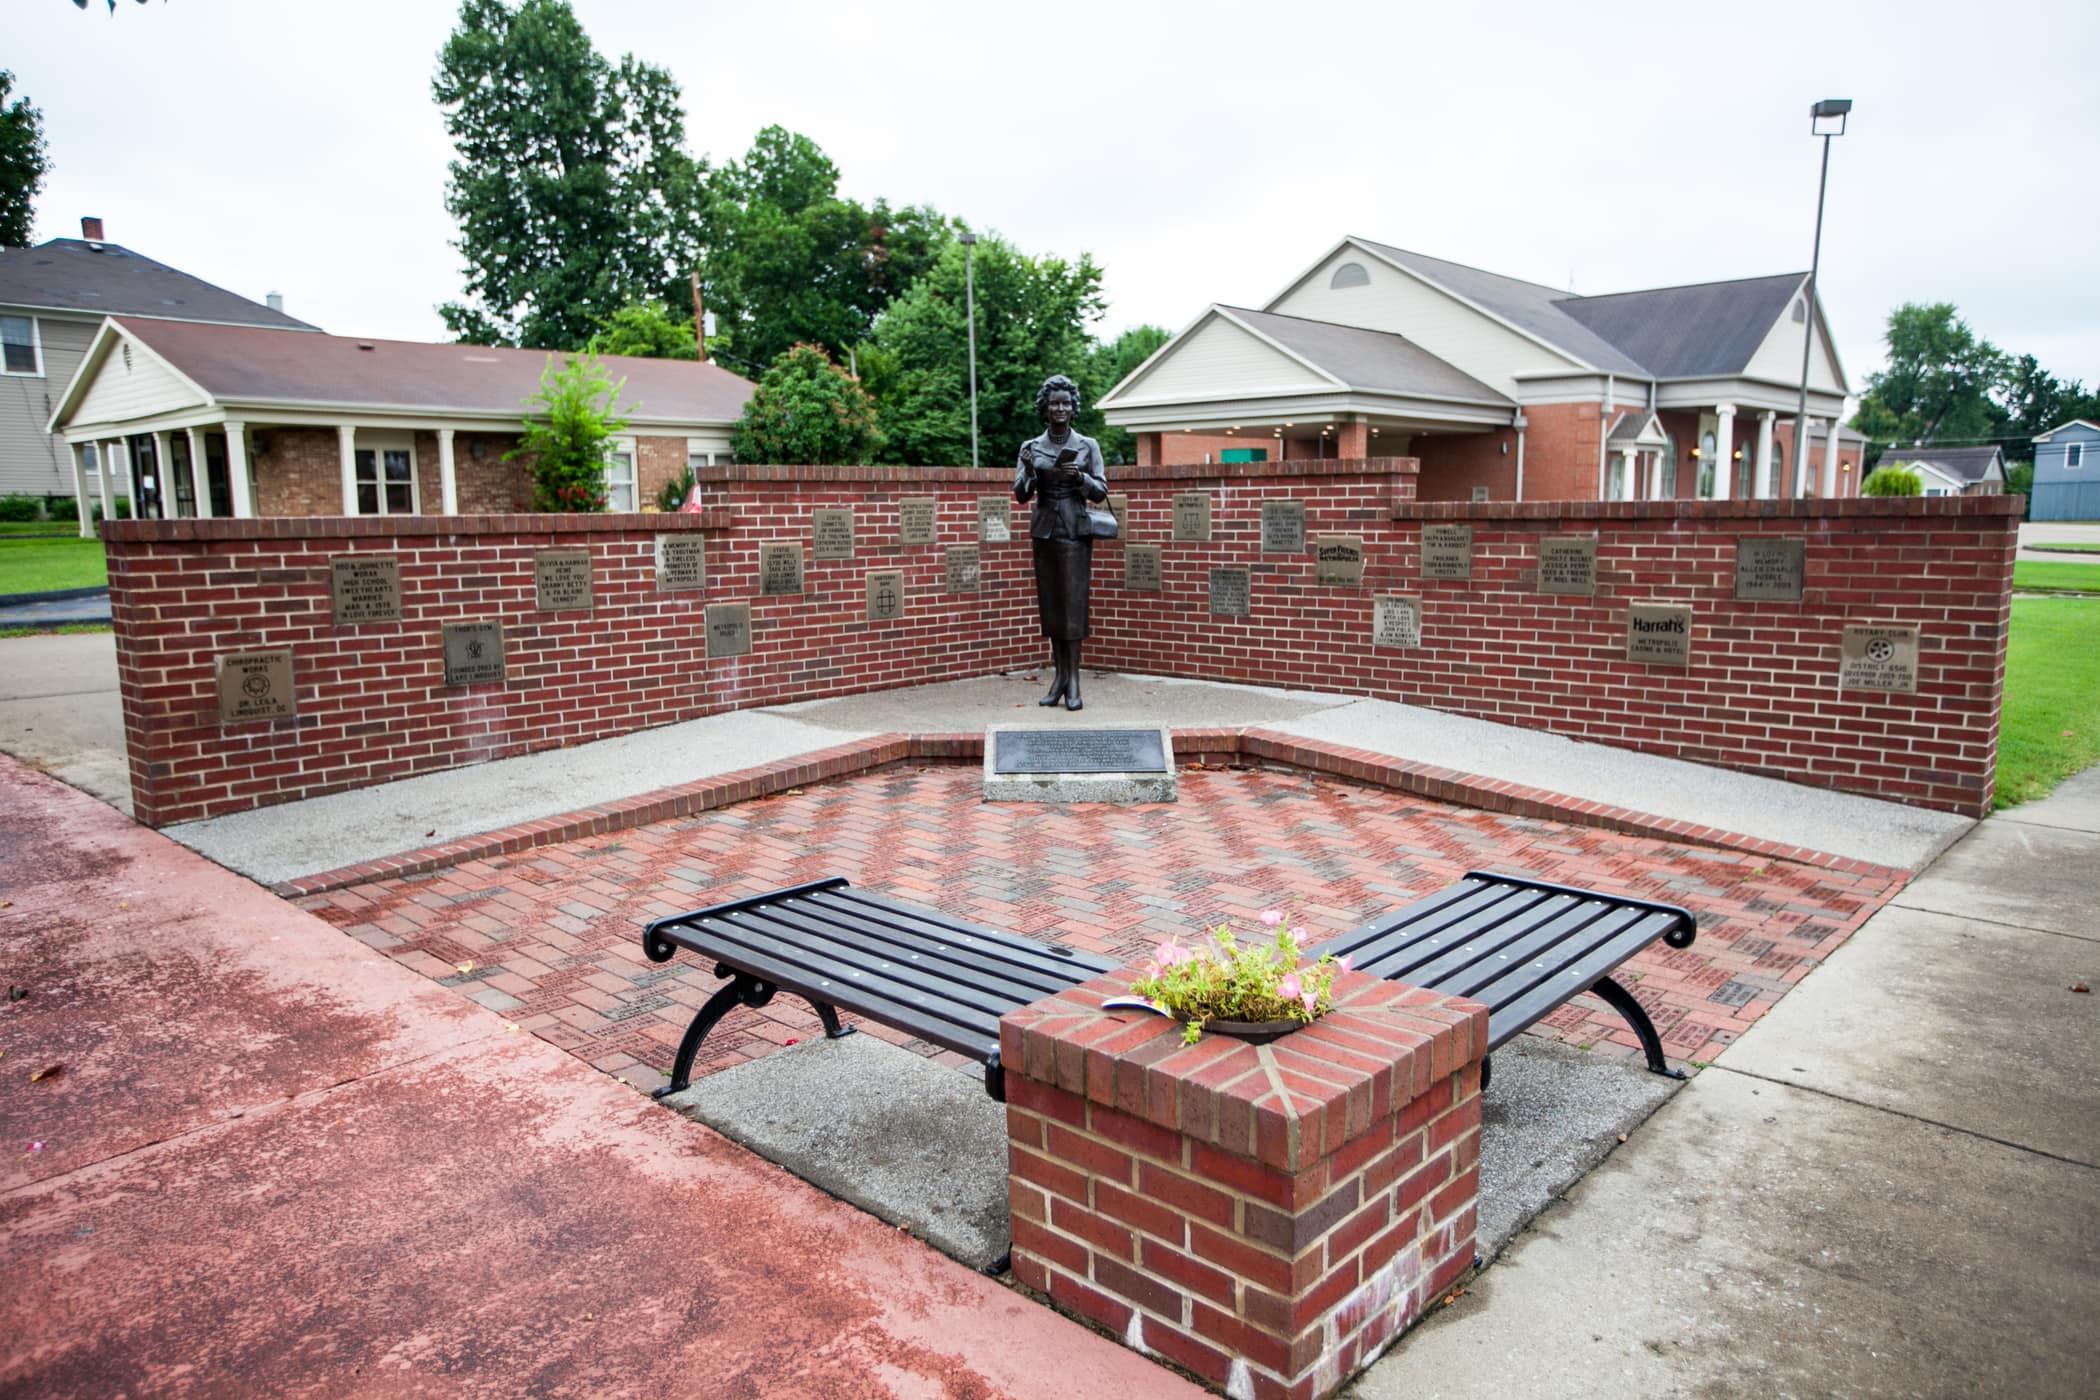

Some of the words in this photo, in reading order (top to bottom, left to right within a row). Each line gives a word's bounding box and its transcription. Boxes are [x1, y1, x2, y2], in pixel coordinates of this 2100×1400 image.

[340, 585, 393, 594] SWEETHEARTS
[352, 594, 383, 602] MARRIED
[350, 610, 365, 618] LOVE
[1632, 616, 1685, 634] Harrah's
[1853, 628, 1884, 636] ROTARY
[1638, 639, 1678, 647] METROPOLIS
[1630, 644, 1653, 652] CASINO
[1663, 647, 1684, 655] HOTEL
[226, 655, 283, 667] CHIROPRACTIC
[242, 665, 269, 674] WORKS
[1849, 662, 1885, 670] DISTRICT
[1864, 679, 1893, 687] MILLER
[254, 697, 277, 706] LEILA
